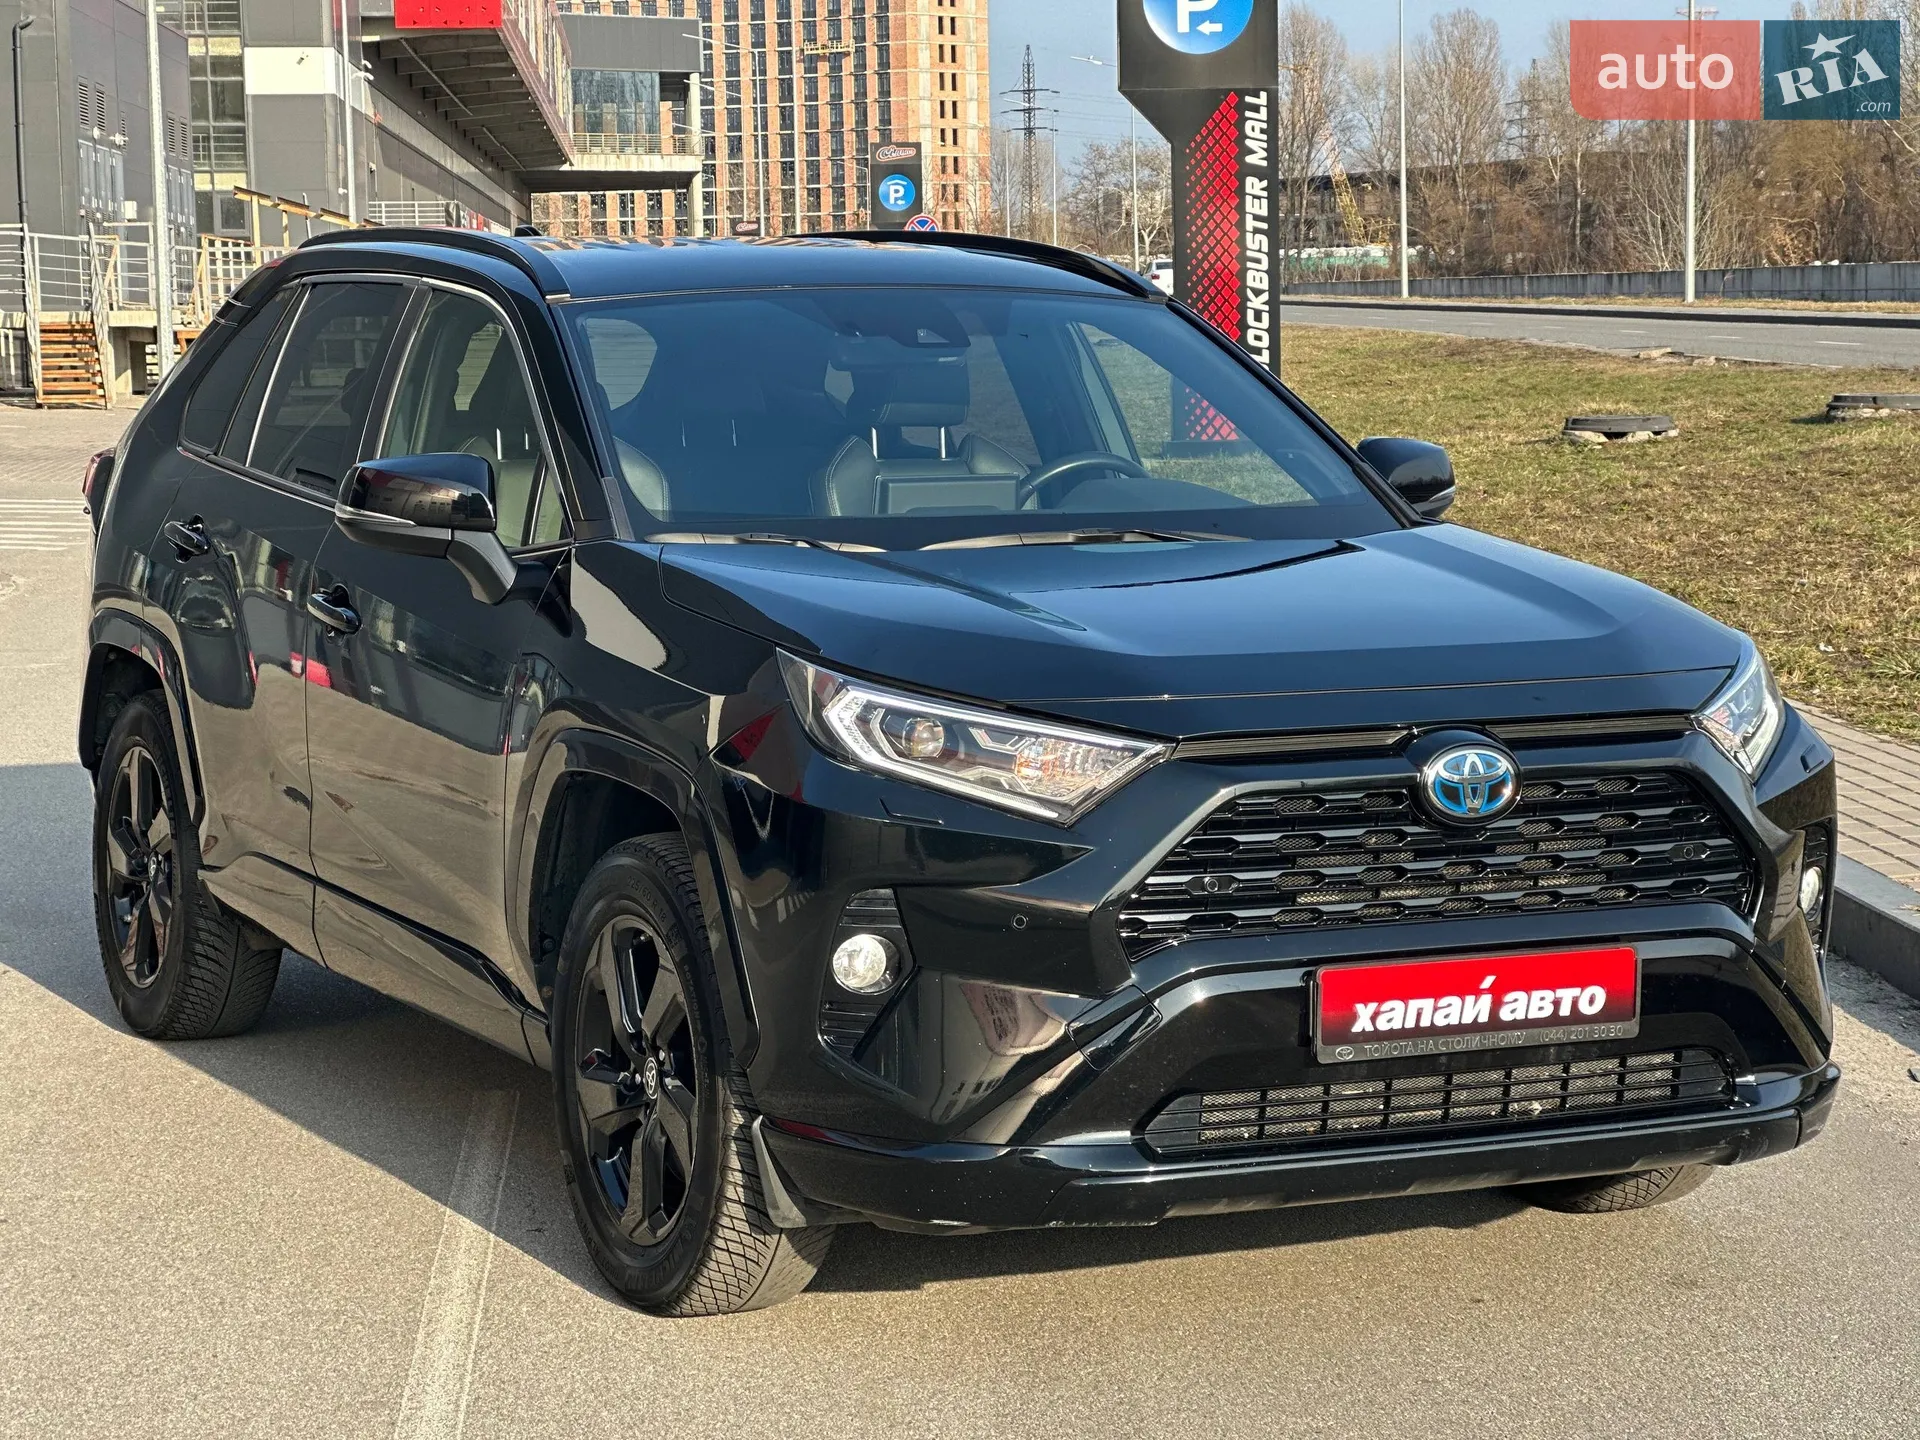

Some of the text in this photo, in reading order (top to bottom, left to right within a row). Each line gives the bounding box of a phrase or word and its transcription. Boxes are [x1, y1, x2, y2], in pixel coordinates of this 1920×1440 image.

[1245, 91, 1270, 371] LOCKBUSTER MALL
[1499, 985, 1607, 1021] авто
[1364, 1024, 1624, 1057] ТОЙОТА НА СТОЛИЧНОМУ (044) 201 30 30
